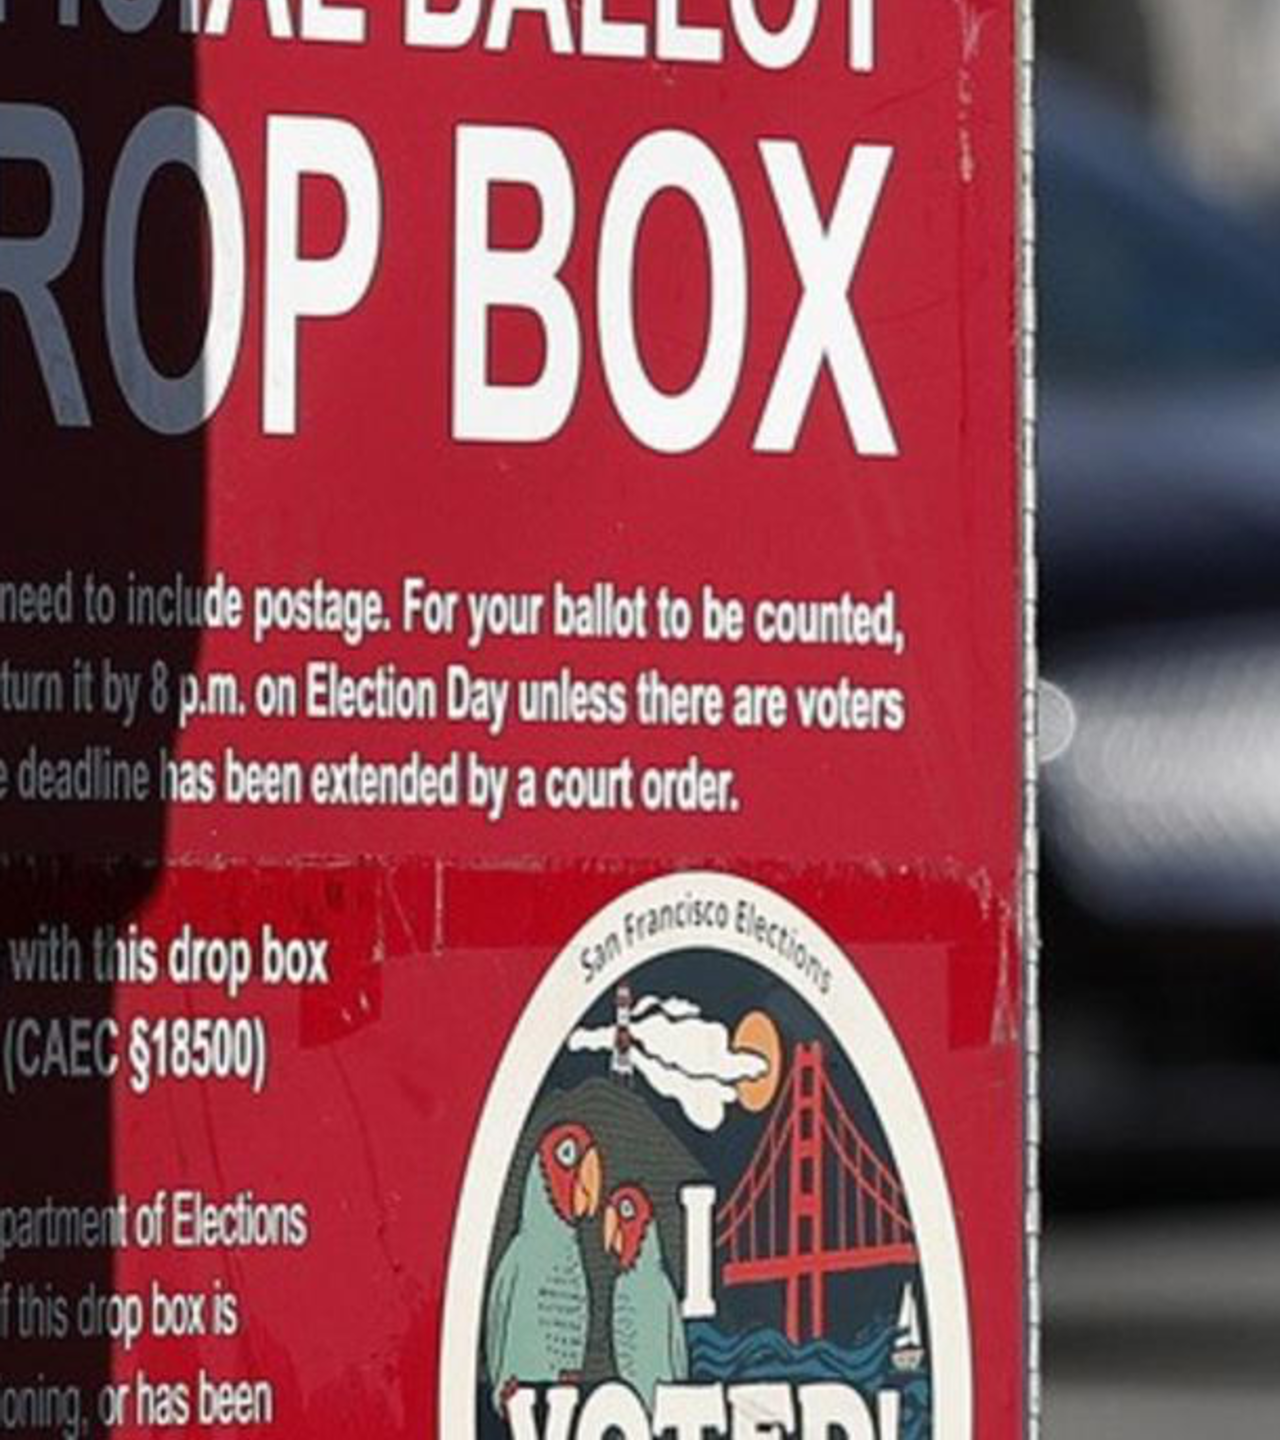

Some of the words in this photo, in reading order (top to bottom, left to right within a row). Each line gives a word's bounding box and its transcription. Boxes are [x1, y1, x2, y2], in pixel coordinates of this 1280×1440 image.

[0, 102, 382, 436] ROP
[452, 120, 900, 458] BOX
[0, 570, 73, 624] need
[85, 576, 116, 624] to
[128, 571, 243, 629] include
[254, 578, 391, 646] postage.
[402, 577, 458, 633] For
[467, 590, 543, 649] your
[553, 581, 647, 640] ballot
[656, 586, 692, 641] to
[702, 584, 744, 642] be
[755, 589, 904, 655] counted,
[1, 662, 62, 713] turn
[73, 658, 95, 713] it
[105, 658, 142, 728] by
[150, 659, 167, 714] 8
[179, 673, 247, 729] p.m.
[256, 674, 297, 718] on
[306, 662, 436, 720] Election
[446, 664, 508, 736] Day
[518, 667, 627, 724] unless
[637, 669, 724, 727] there
[732, 686, 787, 728] are
[797, 676, 905, 731] voters
[18, 746, 149, 801] deadline
[160, 746, 217, 803] has
[225, 747, 301, 804] been
[310, 750, 458, 807] extended
[467, 751, 508, 822] by
[517, 765, 536, 809] a
[545, 757, 633, 810] court
[641, 755, 740, 812] order.
[10, 924, 80, 982] with
[94, 923, 158, 983] this
[169, 923, 250, 998] drop
[262, 924, 329, 985] box
[579, 929, 623, 984] San
[622, 891, 730, 949] Francisco
[734, 898, 833, 995] Elections
[5, 1017, 118, 1094] (CAEC
[130, 1016, 266, 1094] §18500)
[0, 1195, 126, 1261] partment
[136, 1190, 167, 1248] of
[172, 1190, 307, 1248] Elections
[680, 1186, 717, 1317] I
[18, 1282, 68, 1339] this
[78, 1282, 142, 1351] drop
[152, 1280, 205, 1337] box
[213, 1278, 239, 1336] is
[101, 1383, 130, 1426] or
[136, 1367, 190, 1426] has
[199, 1366, 273, 1425] been
